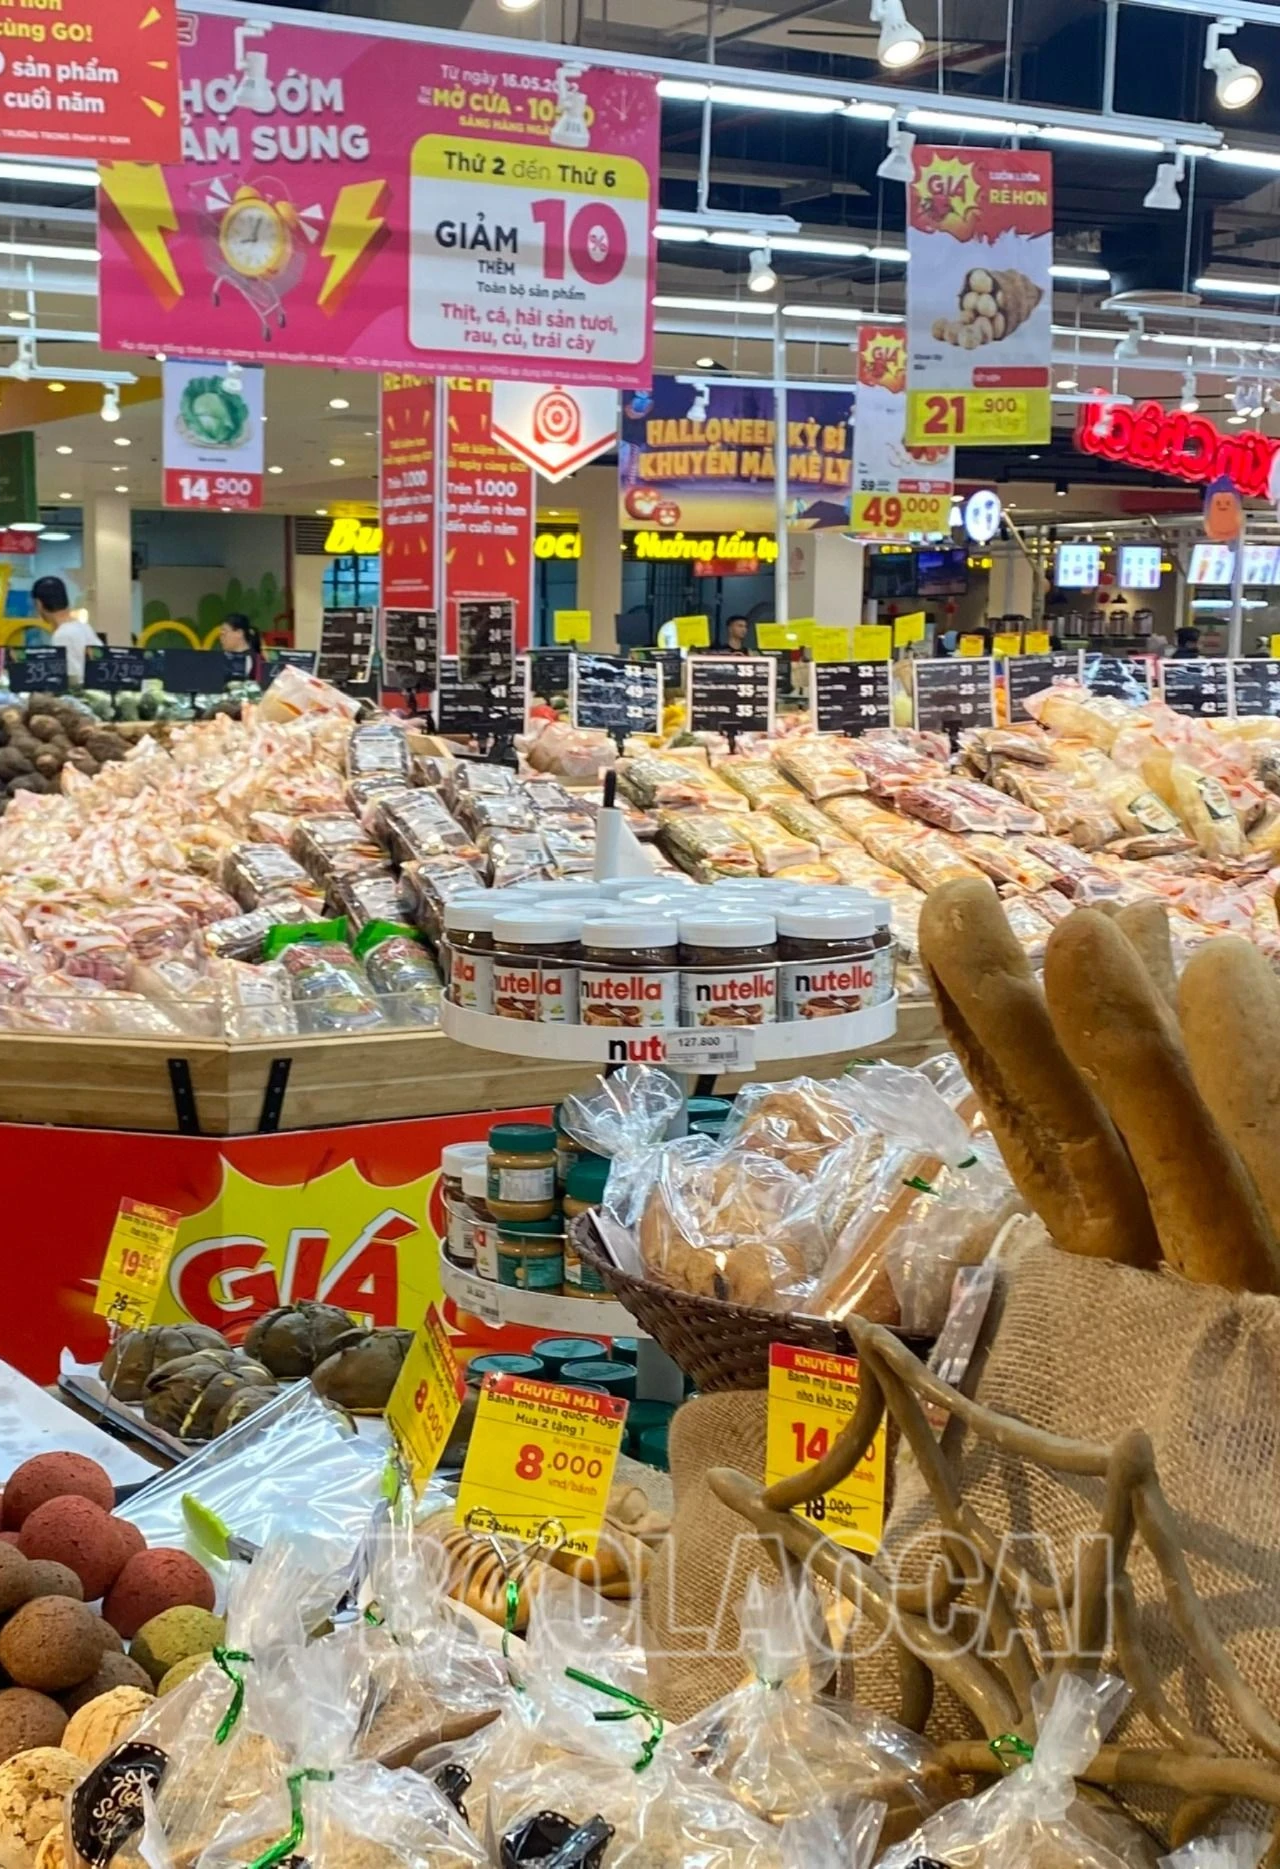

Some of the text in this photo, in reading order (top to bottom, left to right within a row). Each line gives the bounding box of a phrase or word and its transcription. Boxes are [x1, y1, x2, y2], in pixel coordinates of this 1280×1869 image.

[52, 22, 93, 42] GO!
[12, 55, 50, 78] sản
[57, 57, 119, 84] phẩm
[440, 63, 579, 95] Từ ngày 16.05.202
[3, 86, 50, 111] cuối
[56, 91, 105, 113] năm
[180, 73, 236, 121] HỢ
[432, 83, 466, 108] MỞ
[470, 88, 512, 115] CỬA
[181, 112, 369, 162] ẢM SUNG
[525, 121, 552, 136] NGÀ
[444, 150, 616, 187] Thứ 2 đến Thứ 6
[928, 174, 968, 202] GIÁ
[1013, 190, 1047, 206] HƠN
[435, 211, 518, 254] GIẢM
[531, 198, 627, 285] 10
[477, 259, 515, 276] THÊM
[477, 281, 506, 294] Toàn
[441, 303, 481, 326] Thịt,
[486, 305, 511, 327] cá,
[515, 307, 541, 326] hải
[546, 310, 575, 330] sản
[464, 328, 498, 347] rau,
[533, 329, 561, 348] trái
[566, 336, 595, 353] cây
[924, 396, 966, 434] 21
[646, 418, 777, 447] HALLOWEE
[823, 421, 846, 454] BÍ
[639, 444, 738, 481] KHUYẾN
[740, 447, 777, 480] MÃ
[823, 457, 852, 486] LY
[179, 477, 211, 501] 14
[863, 496, 902, 527] 49
[634, 531, 715, 561] Nướng
[495, 972, 561, 994] utella
[581, 976, 662, 1001] nutella
[696, 971, 774, 1001] nutella
[795, 966, 873, 992] nutella
[678, 1036, 720, 1047] 127.800
[170, 1208, 419, 1338] GIÁ
[794, 1353, 841, 1375] KHUYẾN
[414, 1379, 428, 1413] 8
[513, 1381, 571, 1404] KHUYẾN
[516, 1413, 538, 1427] Mua
[541, 1418, 549, 1428] 2
[579, 1426, 585, 1436] 1
[792, 1422, 829, 1463] 14
[515, 1443, 545, 1481] 8
[805, 1496, 826, 1521] 18
